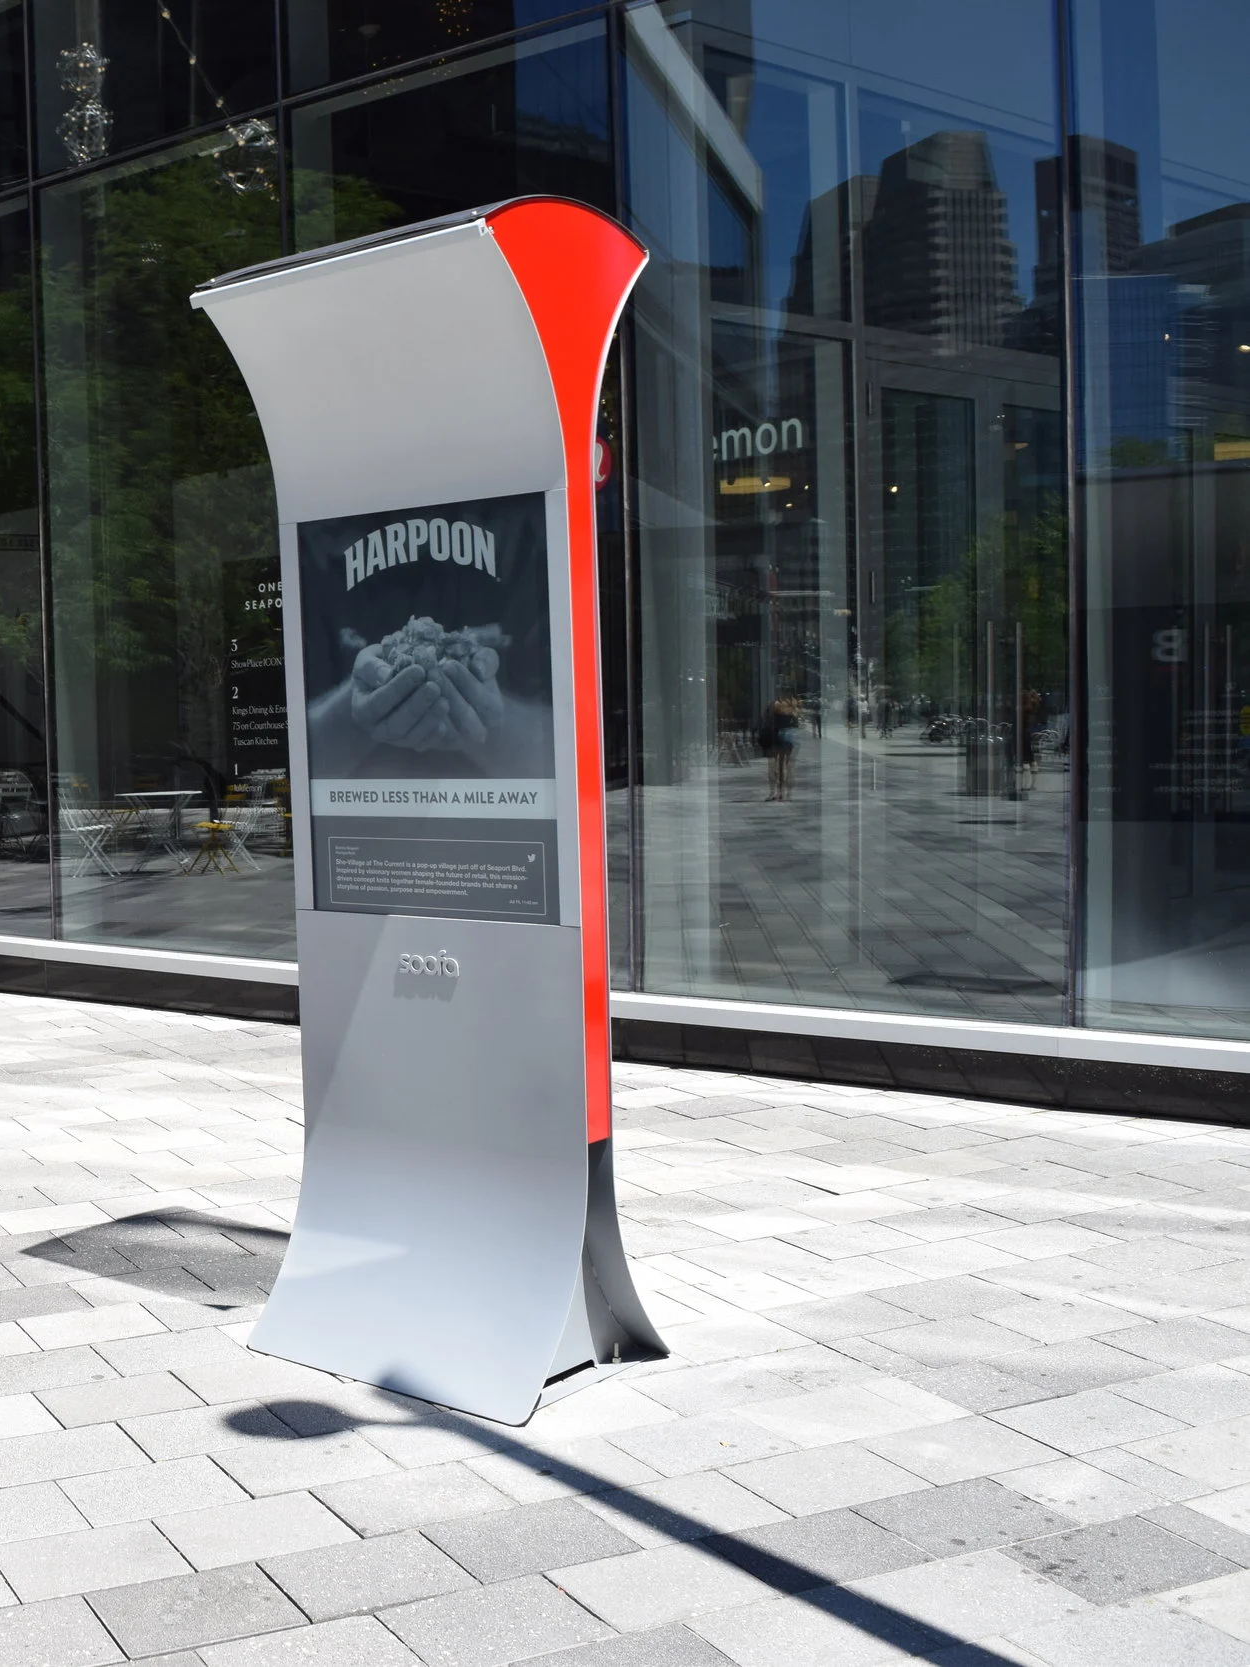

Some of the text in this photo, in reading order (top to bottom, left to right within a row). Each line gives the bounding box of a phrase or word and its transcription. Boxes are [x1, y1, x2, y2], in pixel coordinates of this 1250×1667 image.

[344, 518, 497, 591] HARPOON
[258, 581, 282, 593] ONE
[231, 639, 238, 652] 3
[232, 686, 238, 699] 2
[232, 706, 248, 717] Kings
[249, 705, 268, 716] Dining
[269, 705, 274, 714] &
[232, 721, 240, 730] 75
[250, 720, 285, 730] Courthouse
[233, 736, 278, 746] Tuscan Kitchen
[234, 763, 238, 775] 1
[330, 790, 538, 805] BREWED LESS THAN A MILE AWAY
[384, 860, 405, 868] Current
[438, 862, 457, 871] village
[457, 863, 469, 871] just
[487, 864, 510, 872] Seaport
[358, 868, 365, 876] by
[366, 868, 390, 876] visionary
[412, 869, 434, 878] shaping
[354, 876, 375, 884] concept
[391, 878, 414, 886] together
[415, 878, 460, 887] female-founded
[461, 880, 481, 888] brands
[337, 883, 359, 891] storyline
[366, 885, 389, 893] passion,
[425, 888, 468, 896] empowerment.
[399, 949, 459, 977] soofa
